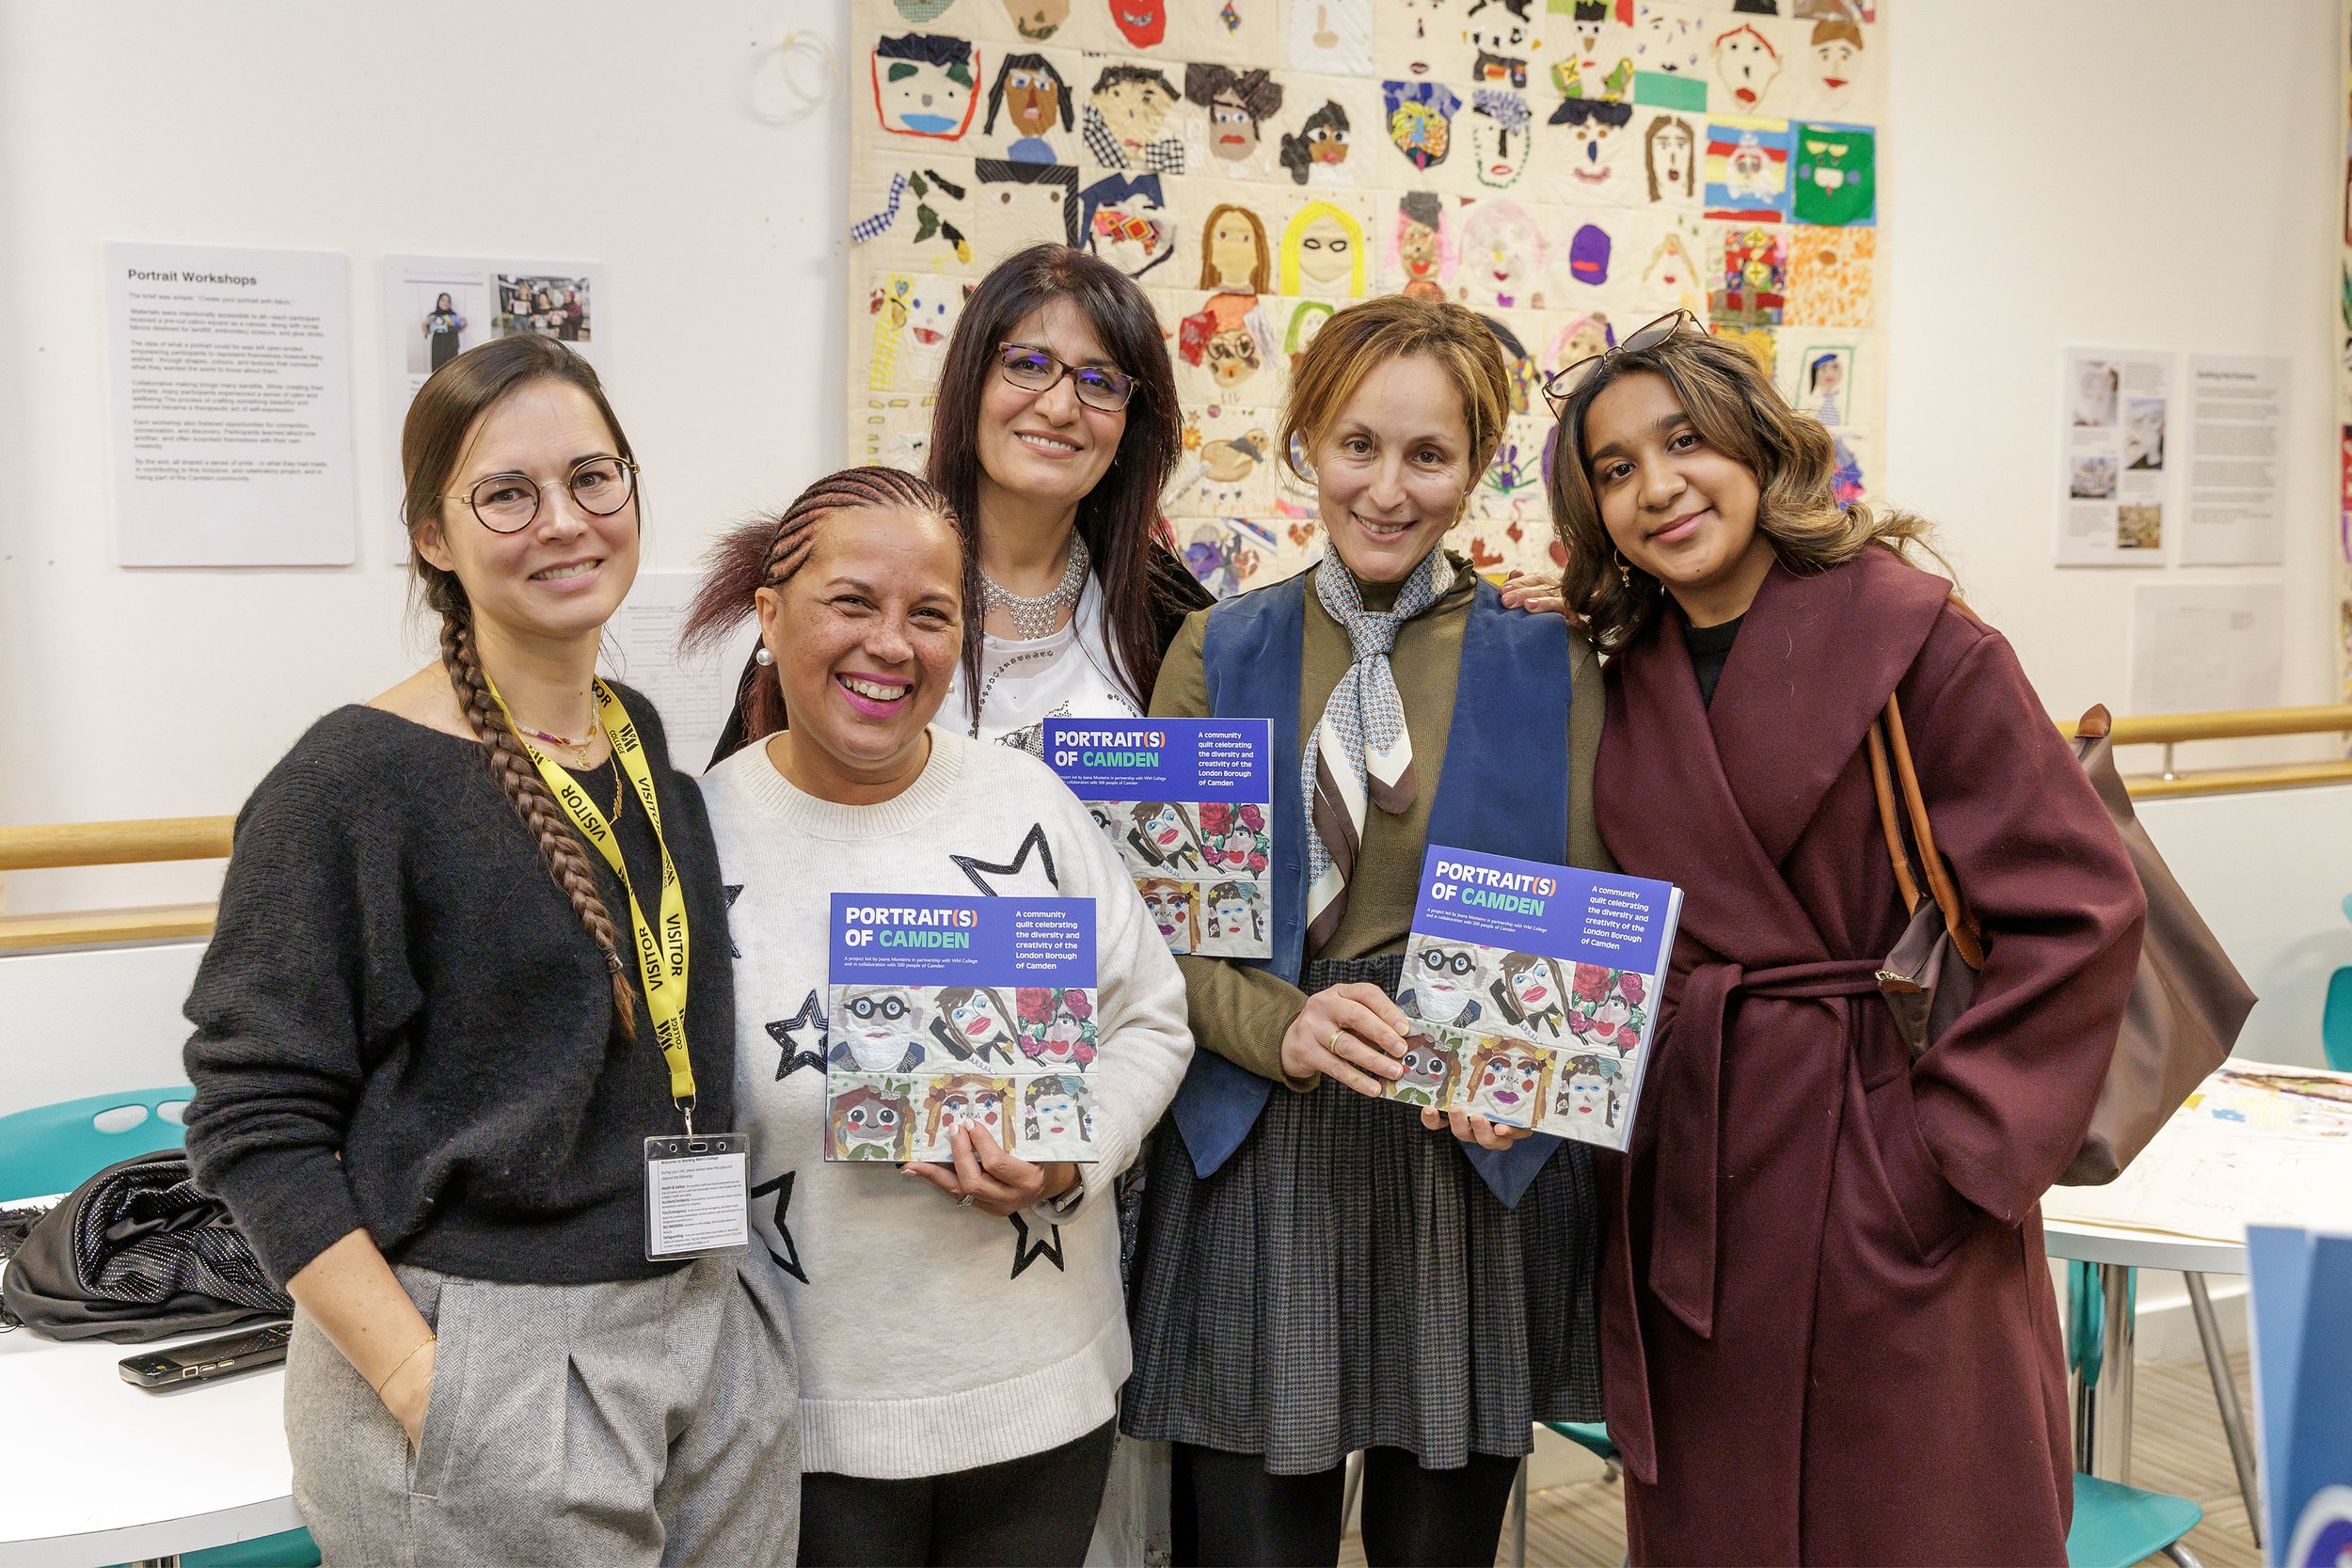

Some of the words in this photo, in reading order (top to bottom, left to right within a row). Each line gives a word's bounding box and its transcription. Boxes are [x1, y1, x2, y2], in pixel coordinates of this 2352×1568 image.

[128, 268, 178, 282] Portrait
[182, 272, 258, 287] Workshops
[609, 729, 626, 754] COLLEGE
[1055, 731, 1166, 748] PORTRAIT(S)
[1055, 751, 1078, 767] OF
[1083, 751, 1159, 768] CAMDEN
[561, 784, 607, 842] VISITOR
[1435, 861, 1557, 896] PORTRAIT(S)
[1431, 882, 1458, 901] OF
[1461, 888, 1546, 917] CAMDEN
[1598, 887, 1640, 899] community
[1590, 896, 1607, 905] quilt
[1608, 899, 1649, 912] celebrating
[846, 907, 977, 927] PORTRAIT(S)
[1601, 909, 1633, 921] diversity
[1583, 927, 1610, 938] London
[1611, 931, 1642, 943] Borough
[1585, 918, 1621, 929] creativity
[1631, 924, 1645, 933] the
[666, 912, 684, 977] VISITOR
[845, 928, 874, 947] OF
[879, 929, 970, 949] CAMDEN
[1030, 931, 1064, 940] diversity
[1591, 939, 1620, 950] Camden
[639, 927, 663, 991] VISITOR
[671, 1016, 683, 1050] COLLEGE
